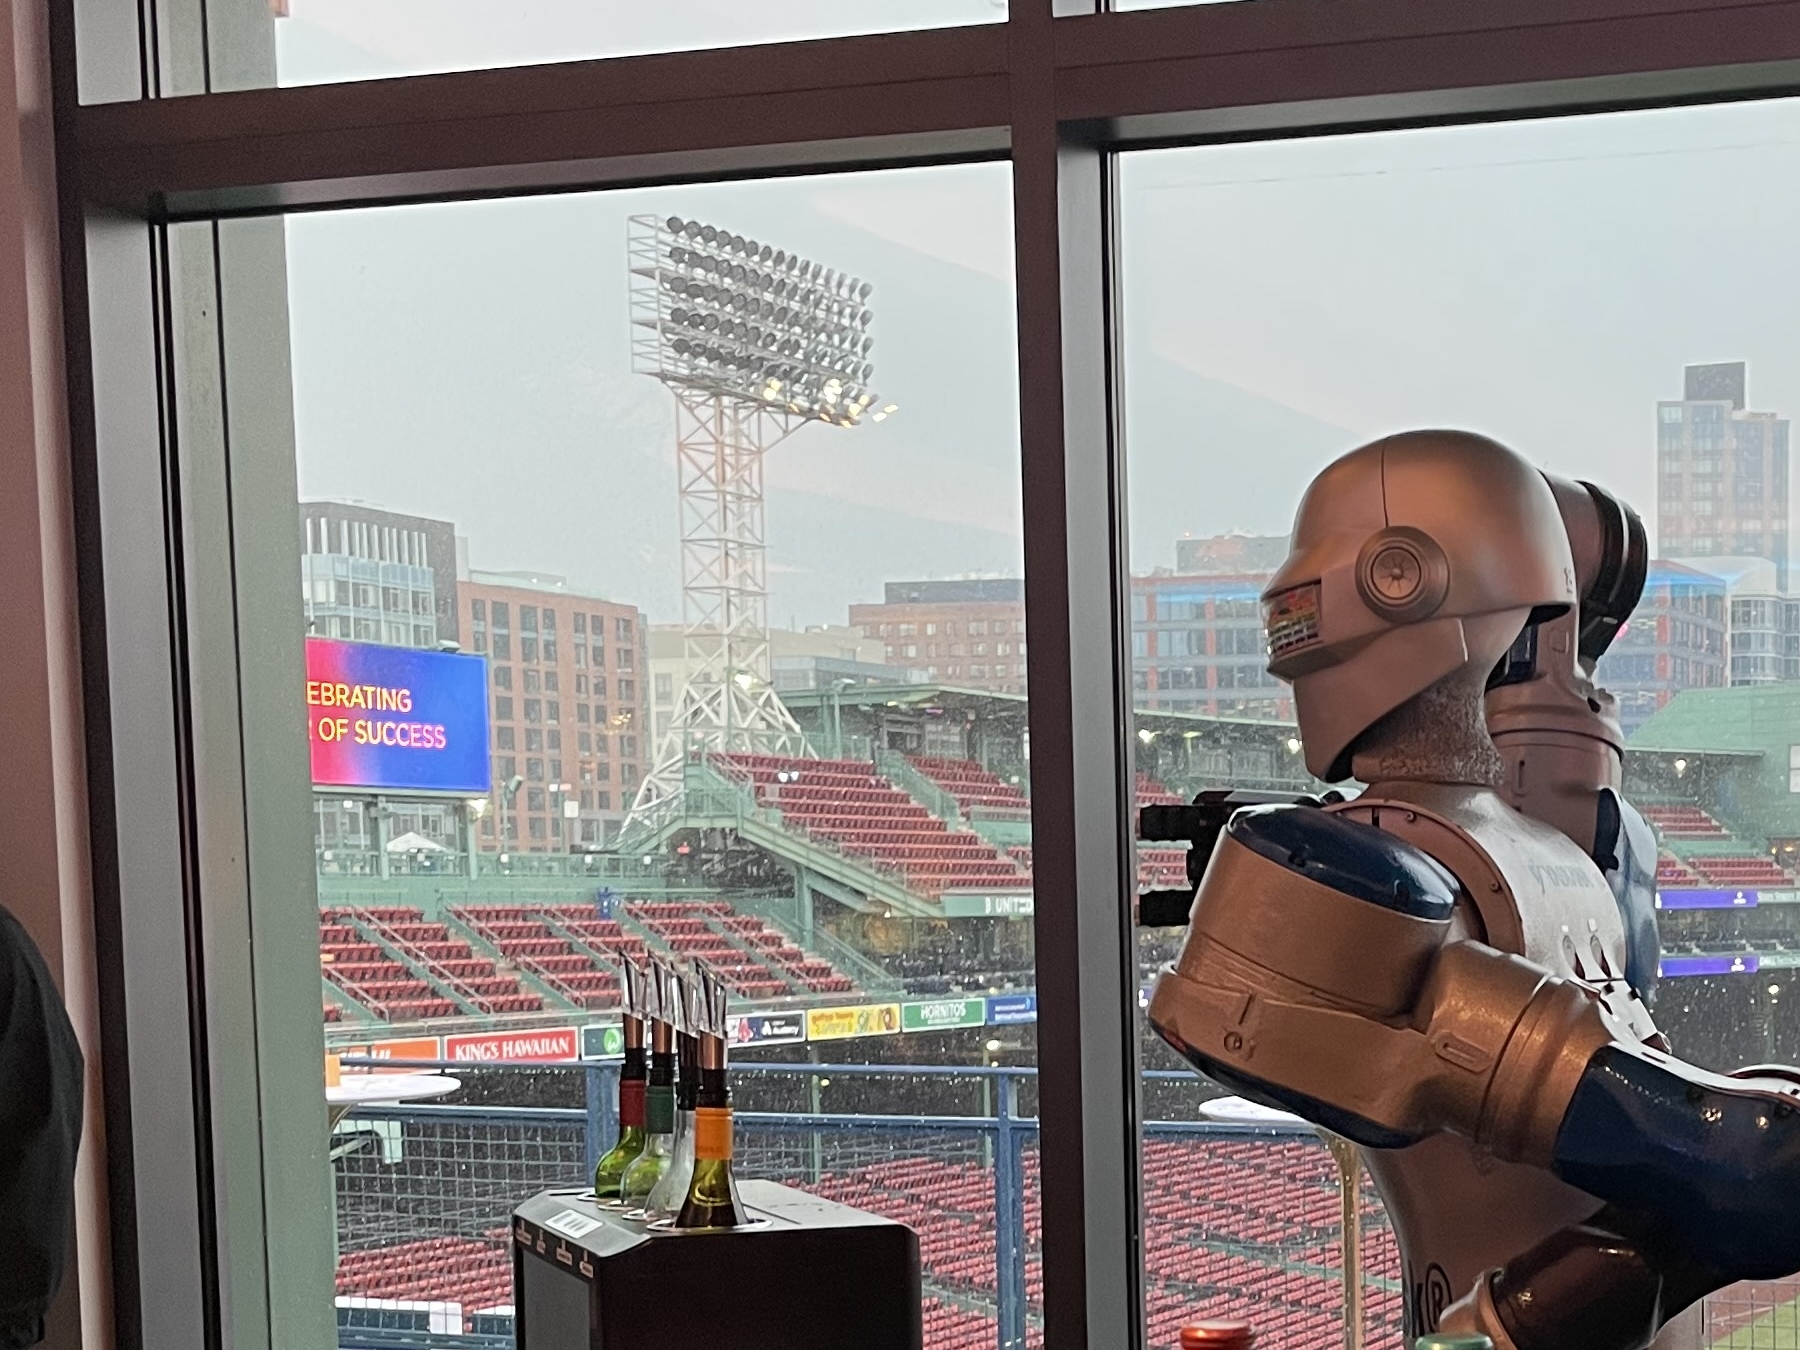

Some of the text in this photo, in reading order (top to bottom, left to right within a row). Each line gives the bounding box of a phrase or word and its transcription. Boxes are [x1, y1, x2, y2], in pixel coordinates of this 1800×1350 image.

[306, 680, 413, 712] EBRATING
[318, 717, 447, 749] OF SUCCESS
[920, 1002, 967, 1020] HORNITOS
[455, 1037, 570, 1061] KING'S HAWAIIAN
